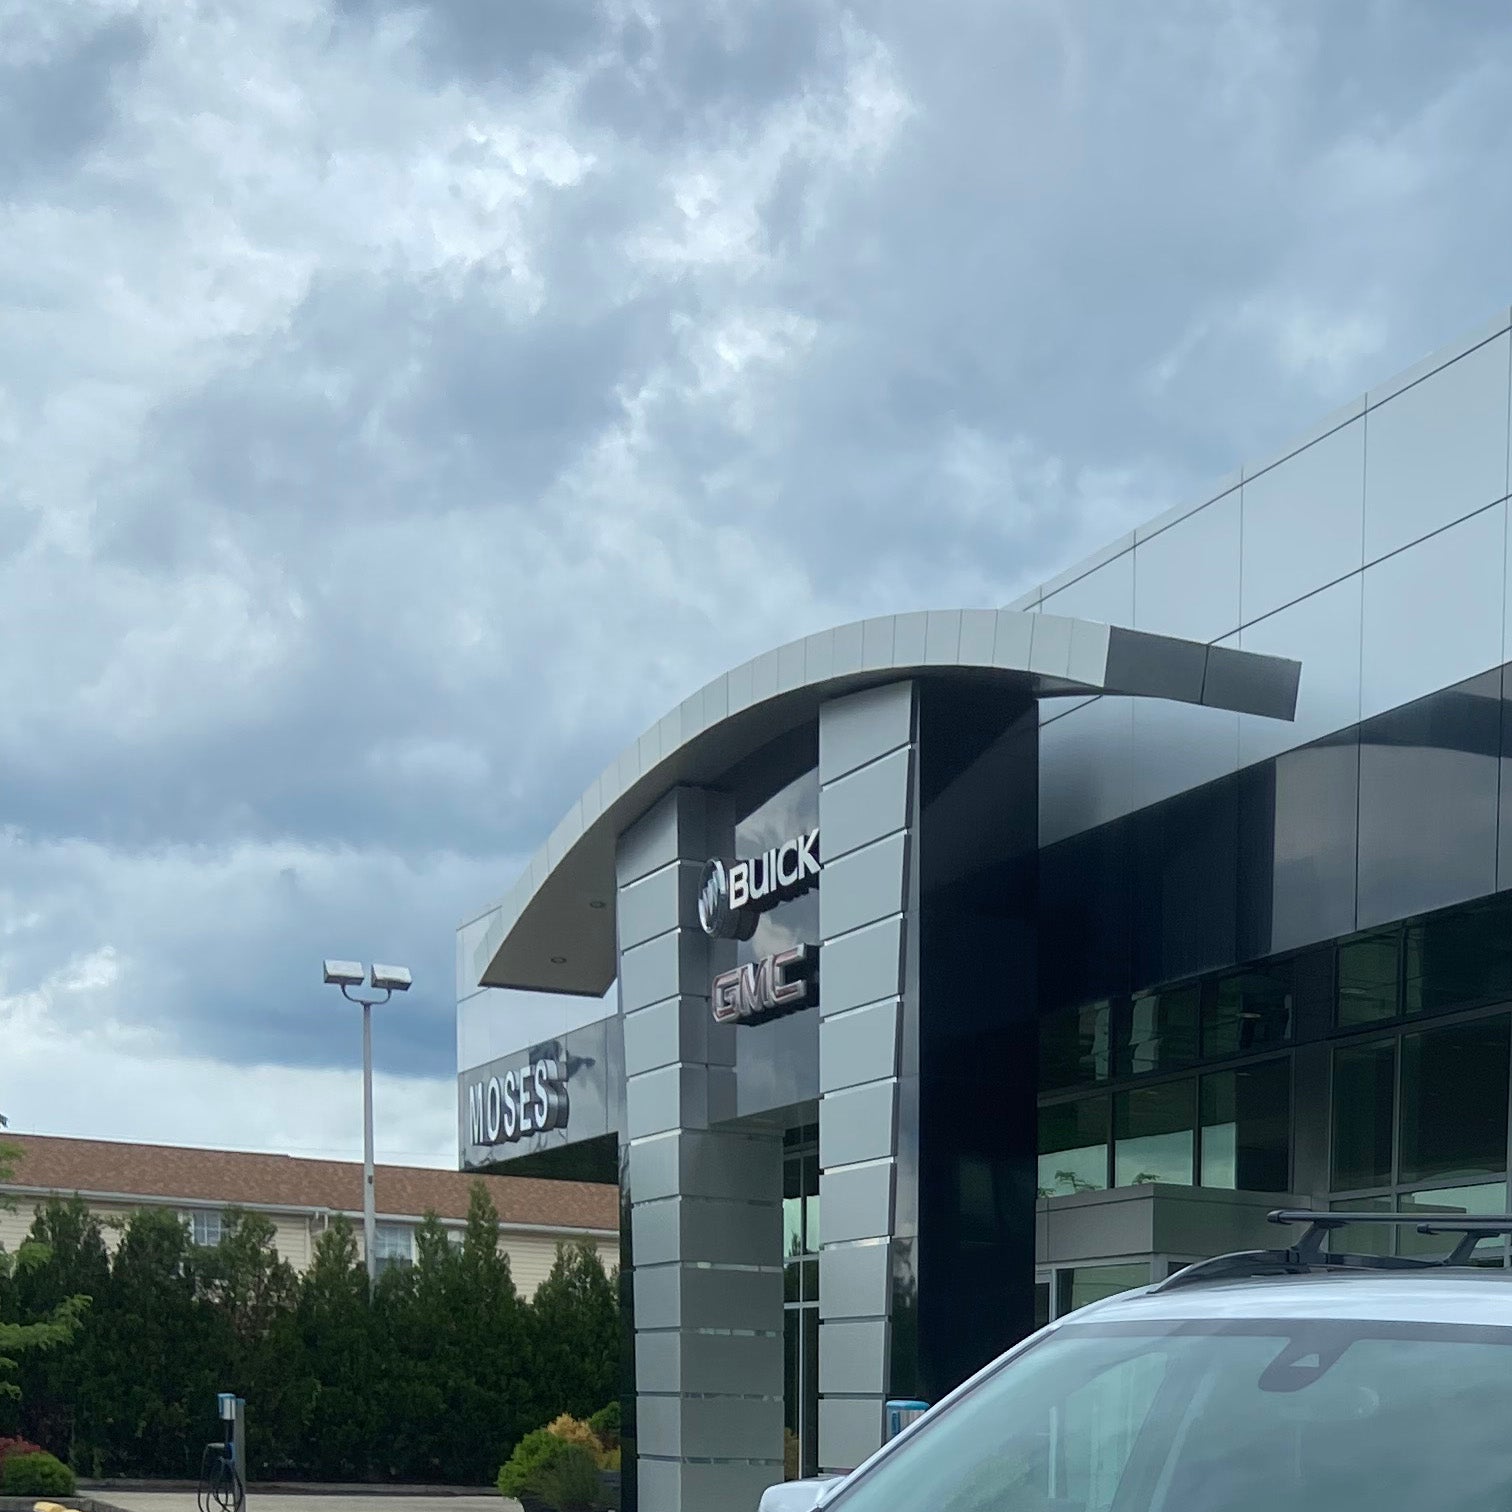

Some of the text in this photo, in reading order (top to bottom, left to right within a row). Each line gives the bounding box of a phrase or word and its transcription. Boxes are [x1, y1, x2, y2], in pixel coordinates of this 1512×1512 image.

[728, 828, 821, 911] BUICK
[711, 942, 808, 1024] GMC
[468, 1058, 554, 1146] MOSES
